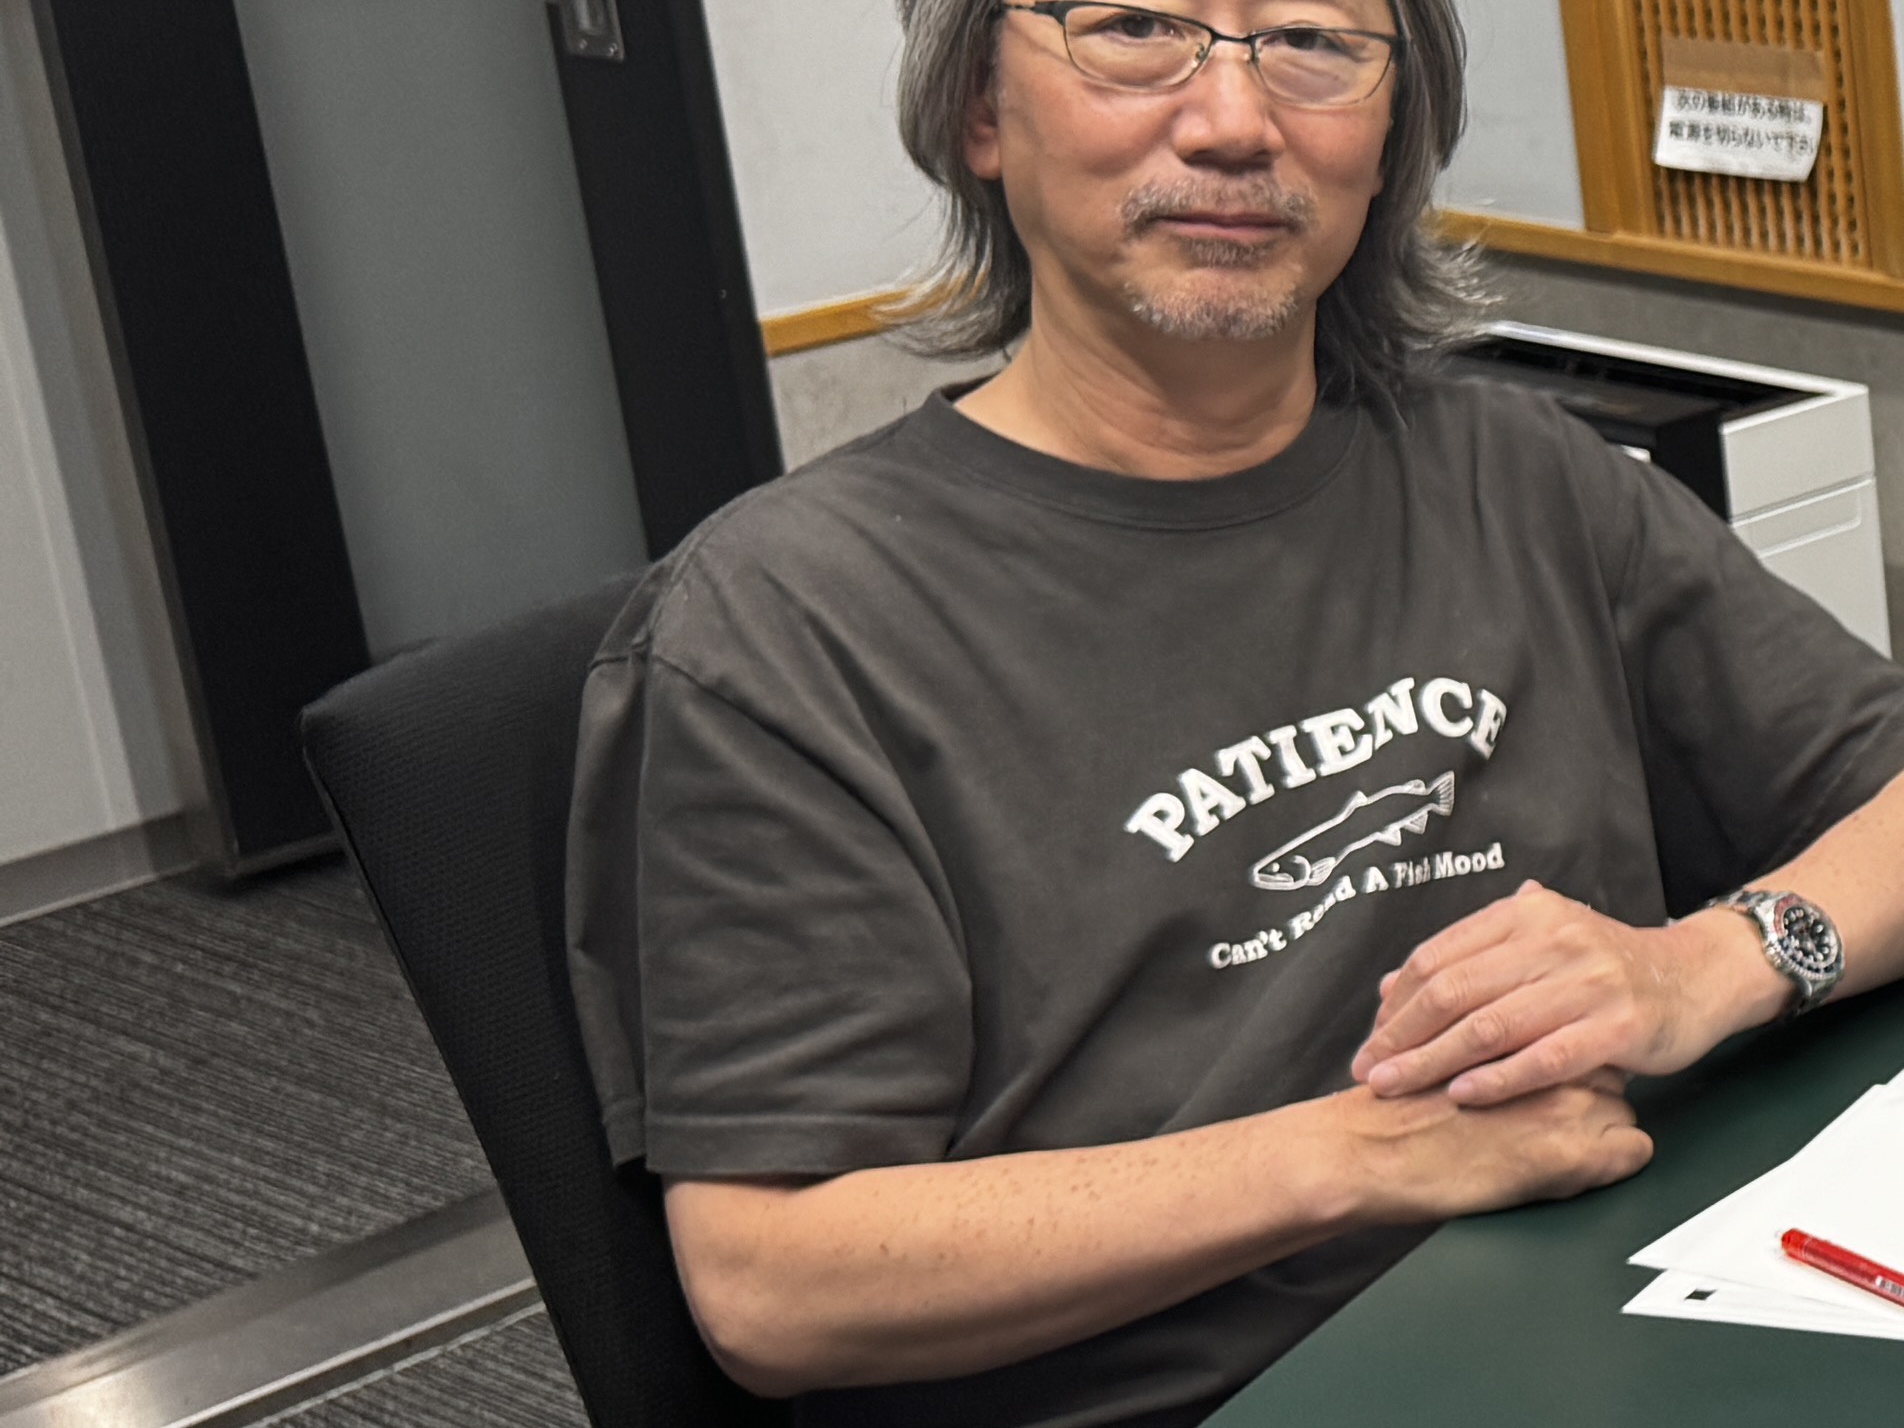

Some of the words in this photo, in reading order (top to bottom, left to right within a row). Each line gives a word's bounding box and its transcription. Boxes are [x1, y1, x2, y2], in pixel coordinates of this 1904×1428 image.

[1124, 677, 1508, 864] PATIENCE
[1289, 876, 1357, 940] Read
[1362, 866, 1389, 893] A
[1434, 842, 1505, 881] Mood
